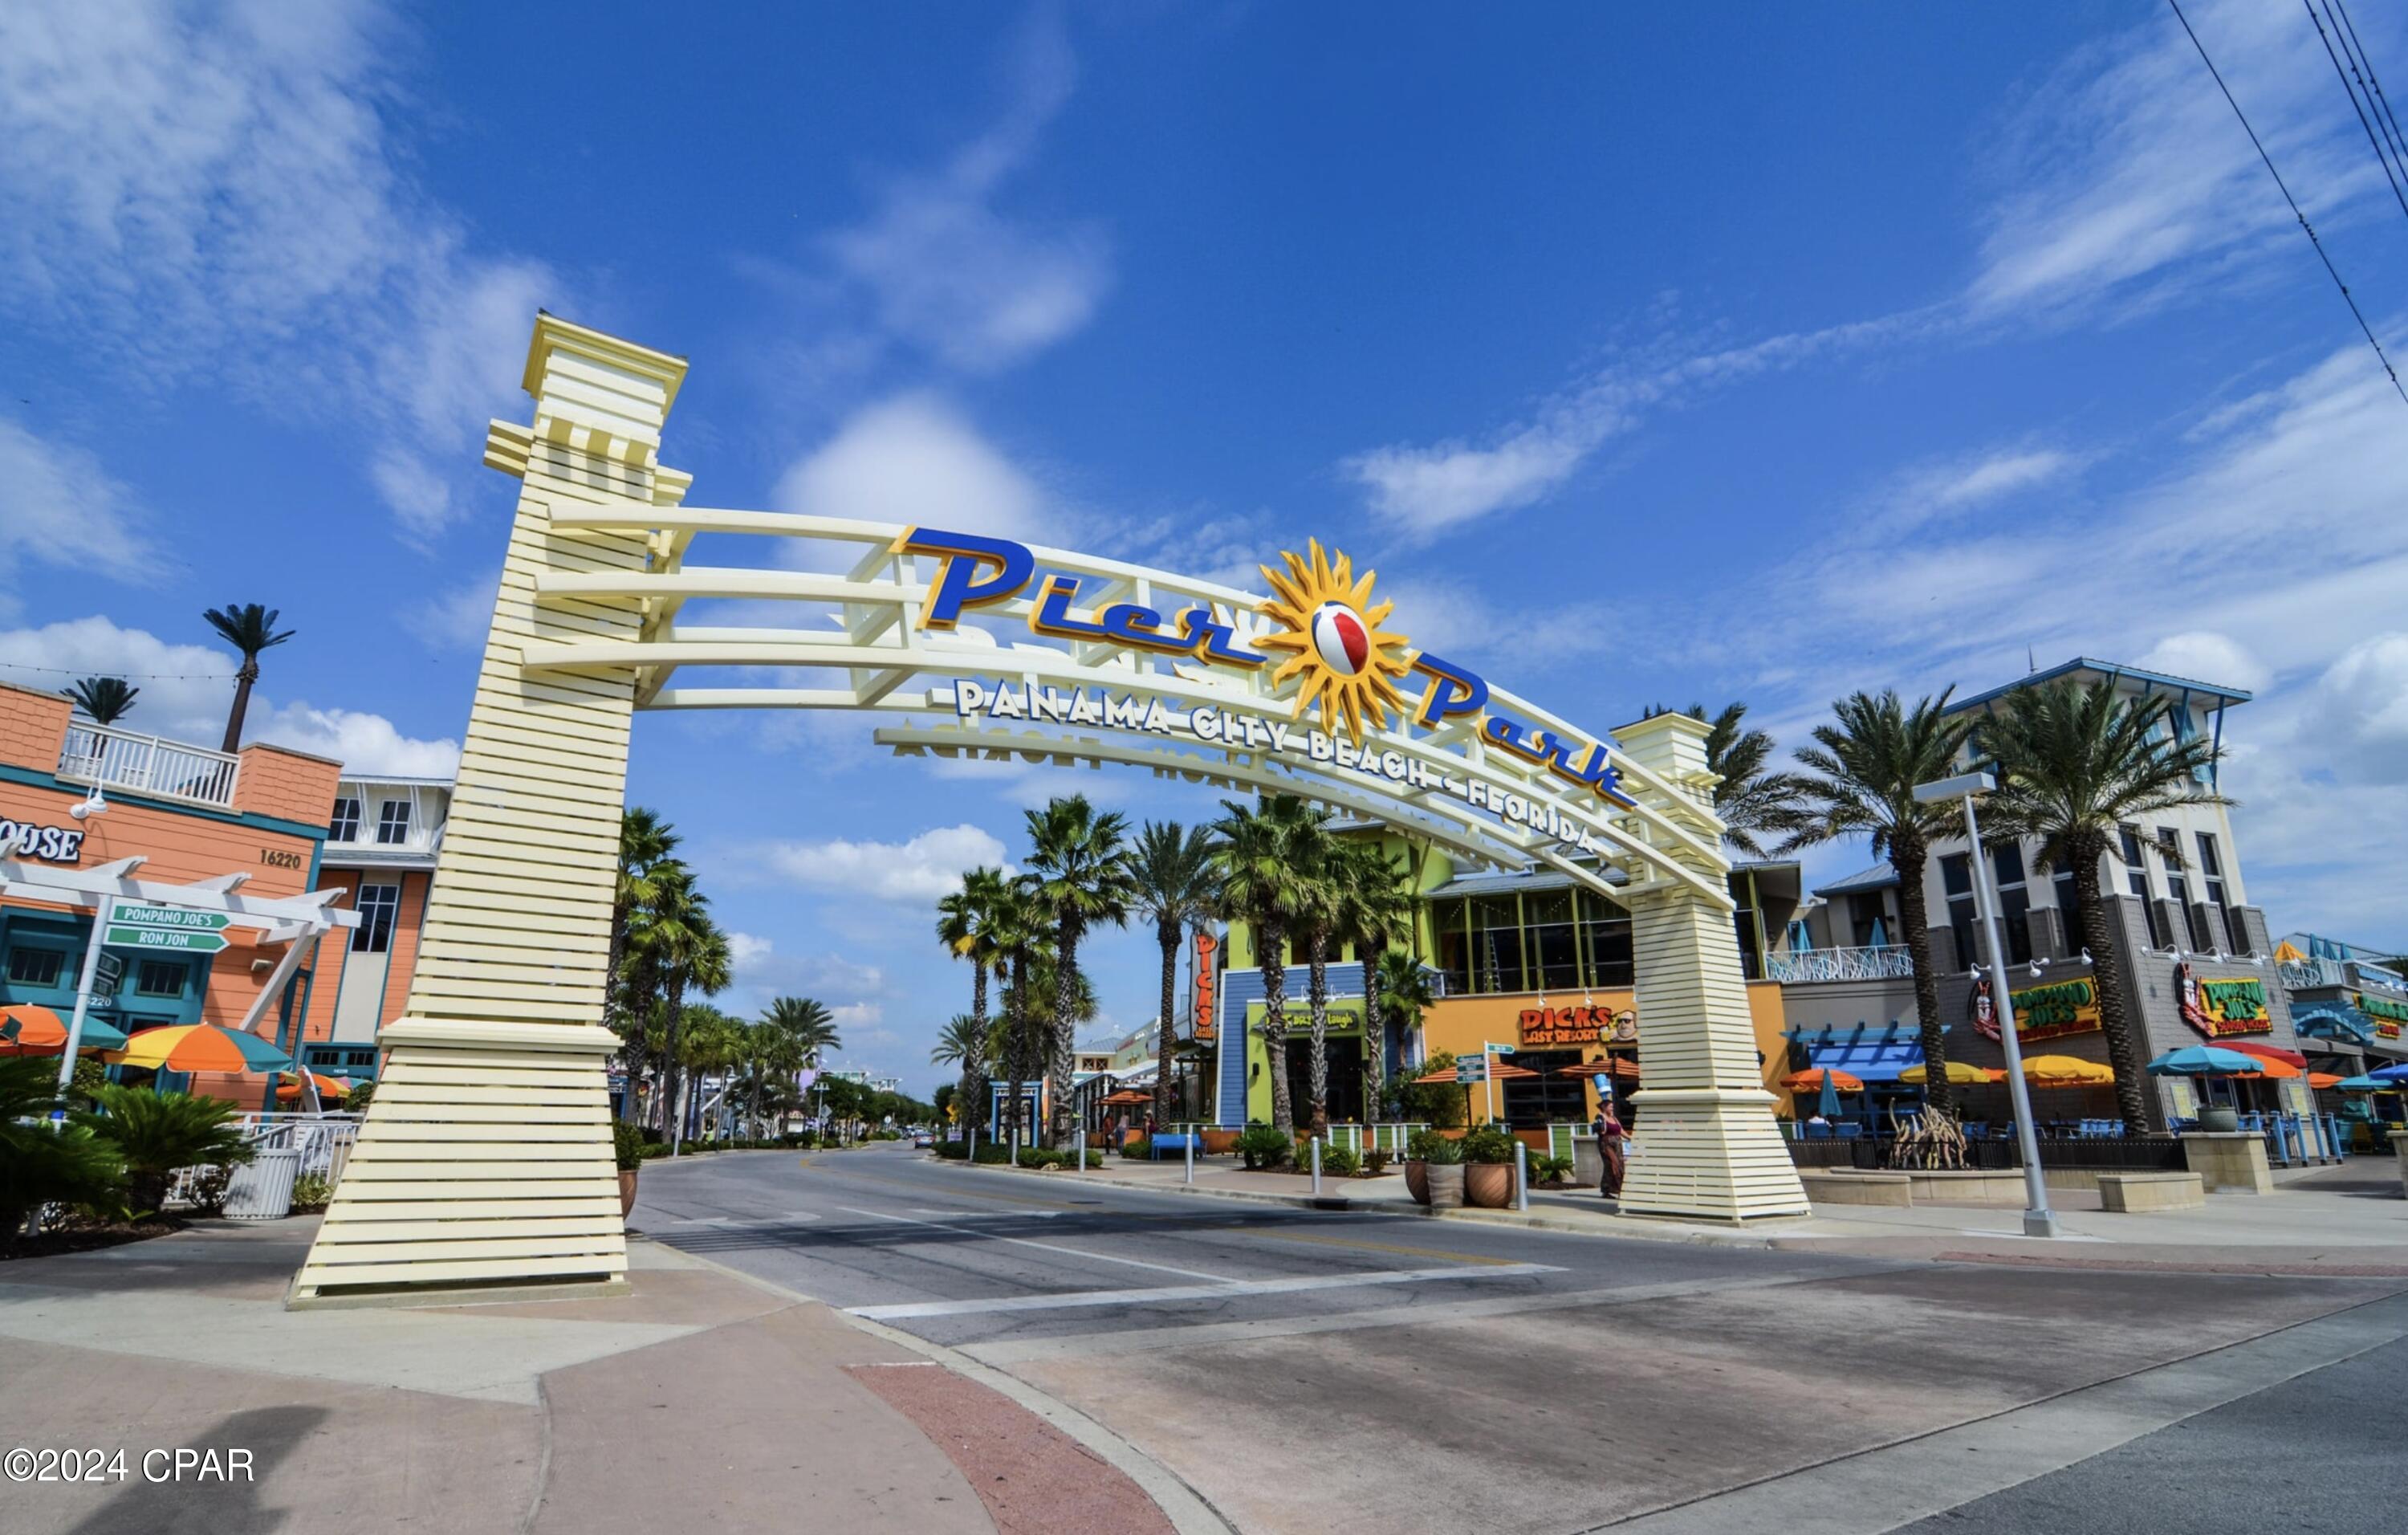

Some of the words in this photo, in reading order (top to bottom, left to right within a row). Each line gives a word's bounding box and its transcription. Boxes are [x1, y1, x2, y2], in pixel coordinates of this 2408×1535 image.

[889, 524, 1268, 670] Pier
[1410, 649, 1639, 812] Park
[954, 678, 1171, 734] PANAMA
[1190, 706, 1288, 753] CITY
[1308, 729, 1428, 789] BEACH
[261, 849, 301, 869] 16220
[124, 908, 181, 924] POMPANO
[181, 913, 212, 926] JOE'S
[138, 931, 164, 944] RON
[165, 934, 189, 947] JON
[1520, 1005, 1612, 1030] DICK'S
[1523, 1031, 1553, 1044] LAST
[1554, 1028, 1599, 1043] RESORT
